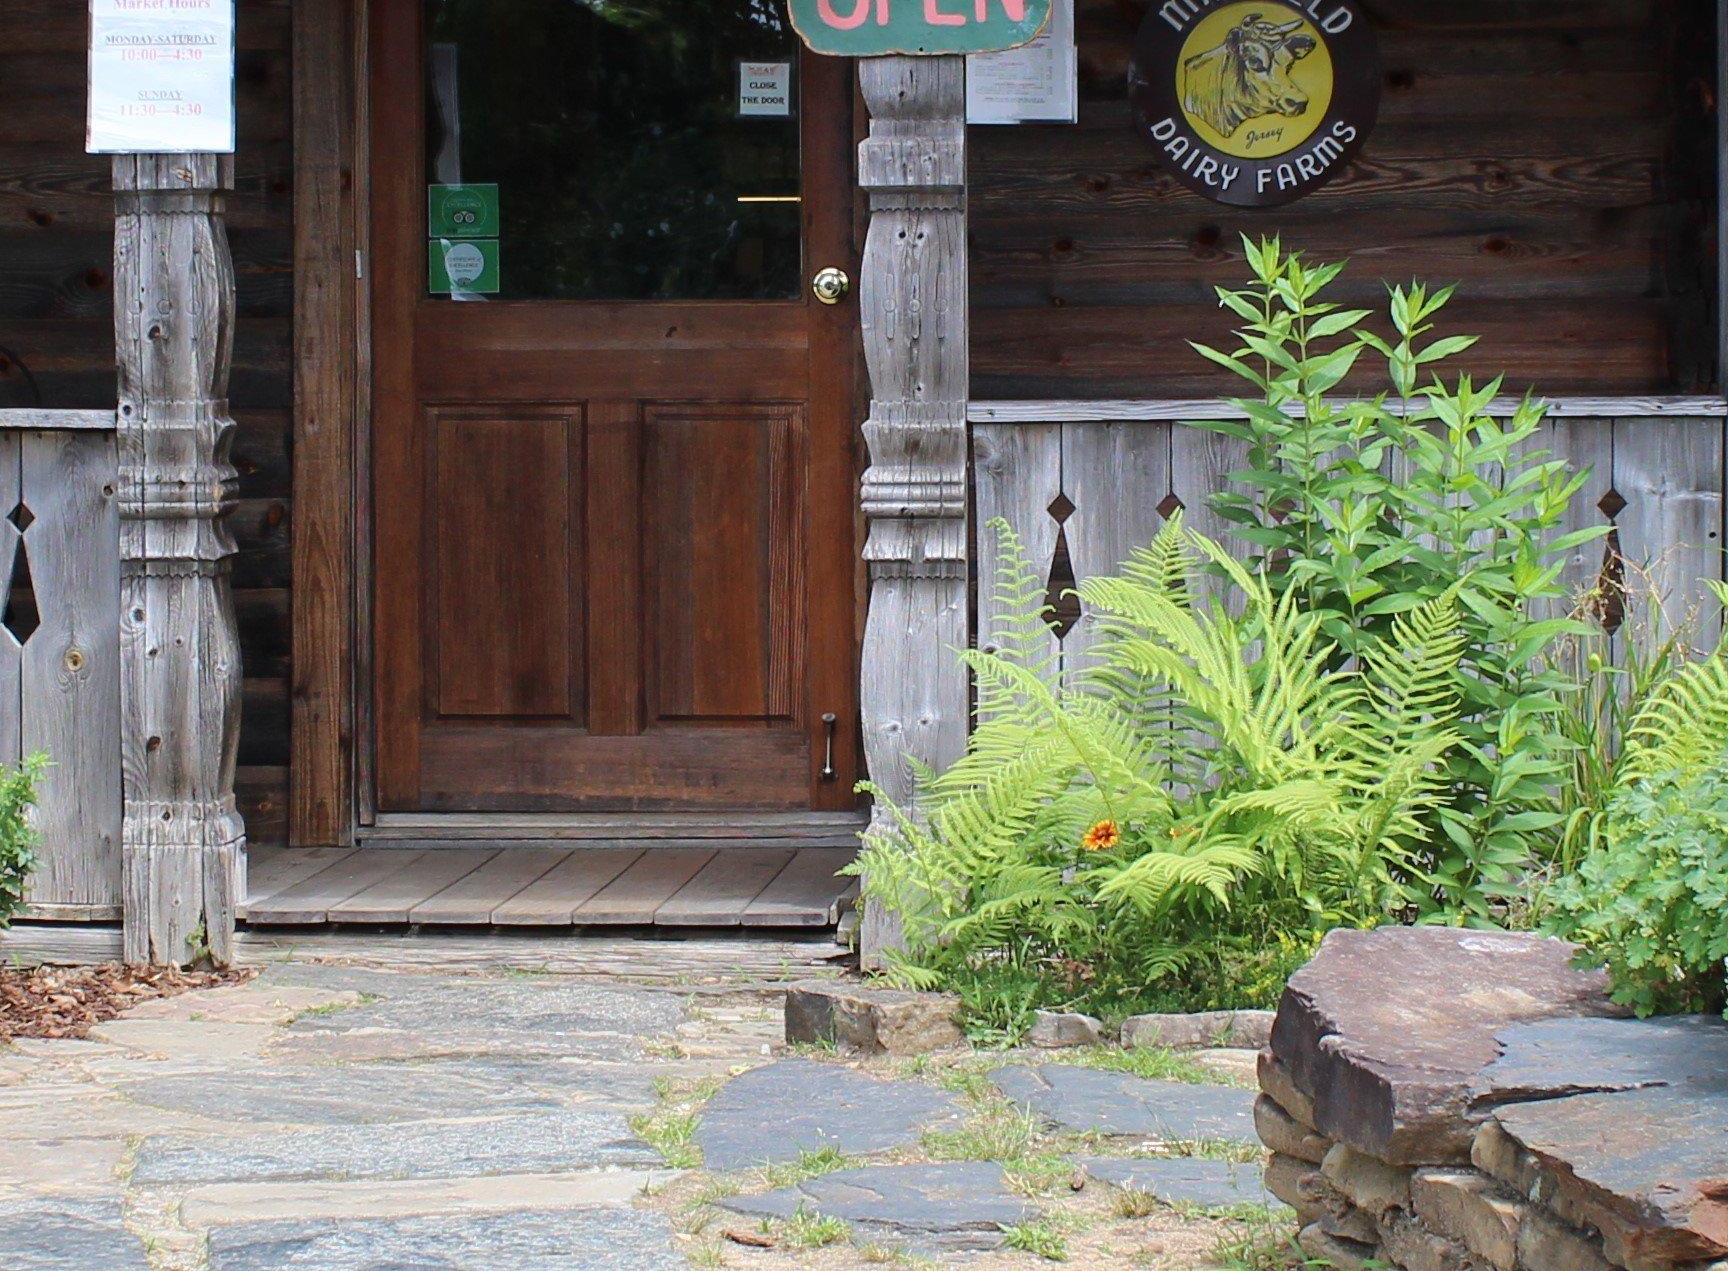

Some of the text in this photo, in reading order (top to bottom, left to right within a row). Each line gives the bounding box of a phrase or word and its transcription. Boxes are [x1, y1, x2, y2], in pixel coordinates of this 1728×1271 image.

[106, 34, 217, 45] MONDAY-SATURDAY
[749, 81, 778, 89] CLOSE
[137, 90, 184, 101] SUNDAY
[742, 96, 785, 104] THE DOOR
[1245, 127, 1284, 149] Jersey
[1150, 117, 1357, 193] DAIRY FARMS
